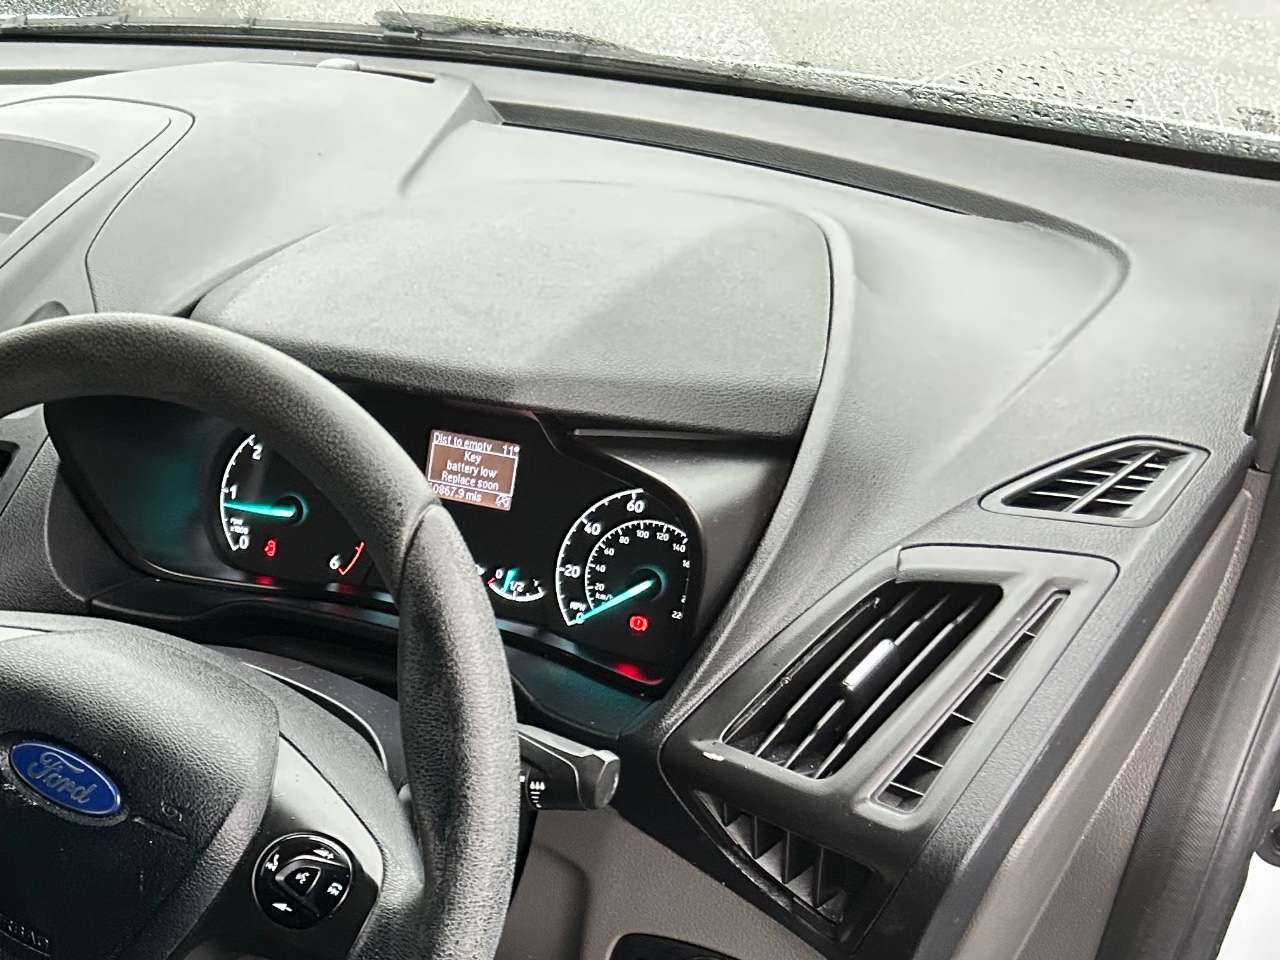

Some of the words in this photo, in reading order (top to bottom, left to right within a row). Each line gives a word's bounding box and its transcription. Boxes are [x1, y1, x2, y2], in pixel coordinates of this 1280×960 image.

[251, 443, 263, 460] 2
[453, 437, 463, 448] to
[464, 440, 493, 453] empty
[464, 451, 482, 465] Key
[447, 460, 480, 477] battery
[480, 466, 498, 479] low
[442, 471, 477, 487] Replace
[477, 479, 499, 491] soon
[228, 484, 238, 500] 1
[626, 499, 645, 514] 60
[584, 521, 602, 536] 40
[636, 529, 650, 540] 100
[239, 534, 250, 550] 0
[618, 535, 630, 545] 80
[656, 531, 669, 542] 120
[604, 546, 615, 556] 60
[673, 543, 686, 553] 140
[329, 554, 340, 570] 6
[595, 563, 606, 573] 40
[495, 568, 504, 579] 0
[563, 563, 581, 578] 20
[595, 582, 605, 591] 20
[27, 751, 98, 804] Ford
